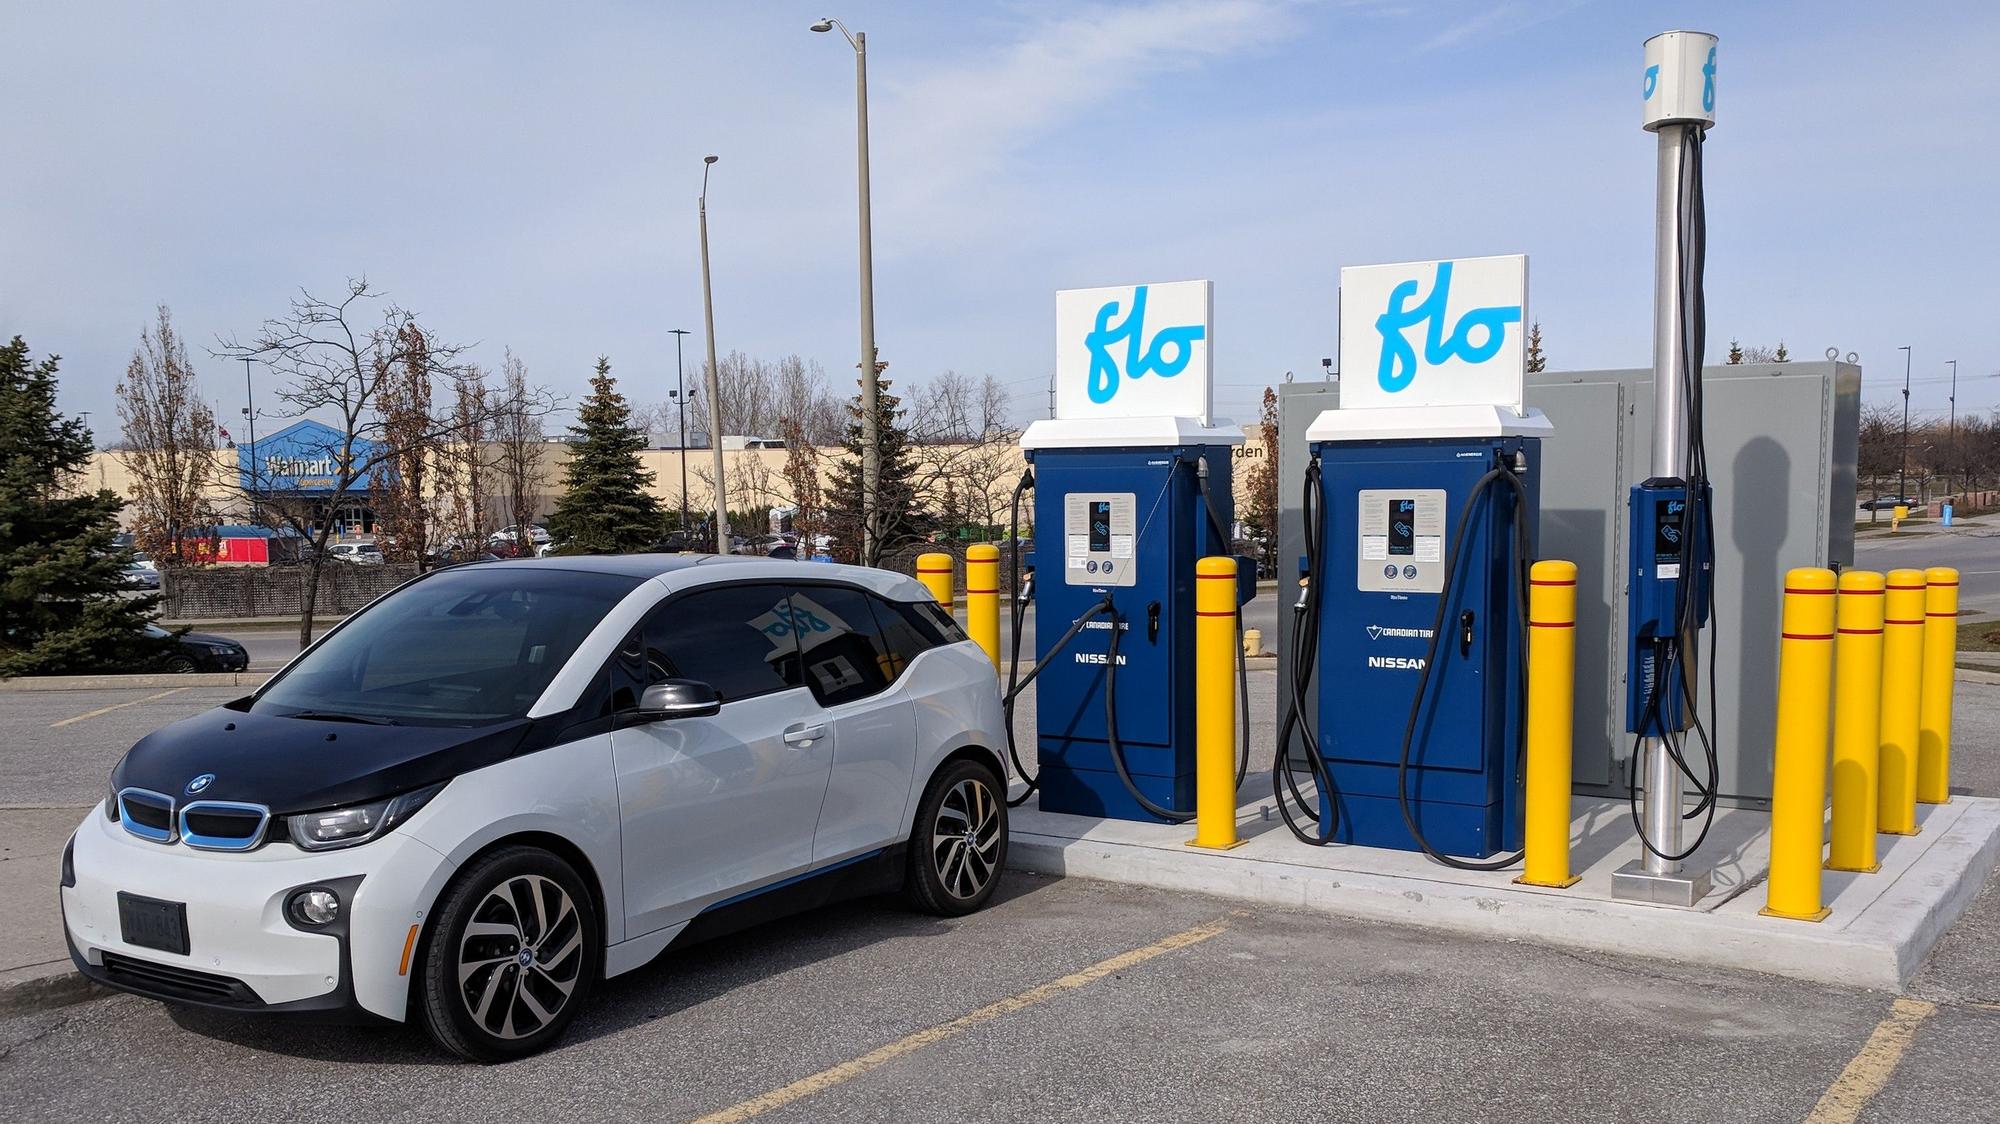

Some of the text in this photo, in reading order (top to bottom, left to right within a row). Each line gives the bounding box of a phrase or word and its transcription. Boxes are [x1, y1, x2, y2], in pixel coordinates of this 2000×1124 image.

[1375, 261, 1521, 393] flo
[1085, 286, 1205, 404] flo
[265, 455, 333, 477] Walmart
[1667, 500, 1685, 514] flo
[1383, 628, 1418, 638] CANADIAN
[1075, 653, 1126, 666] NISSN
